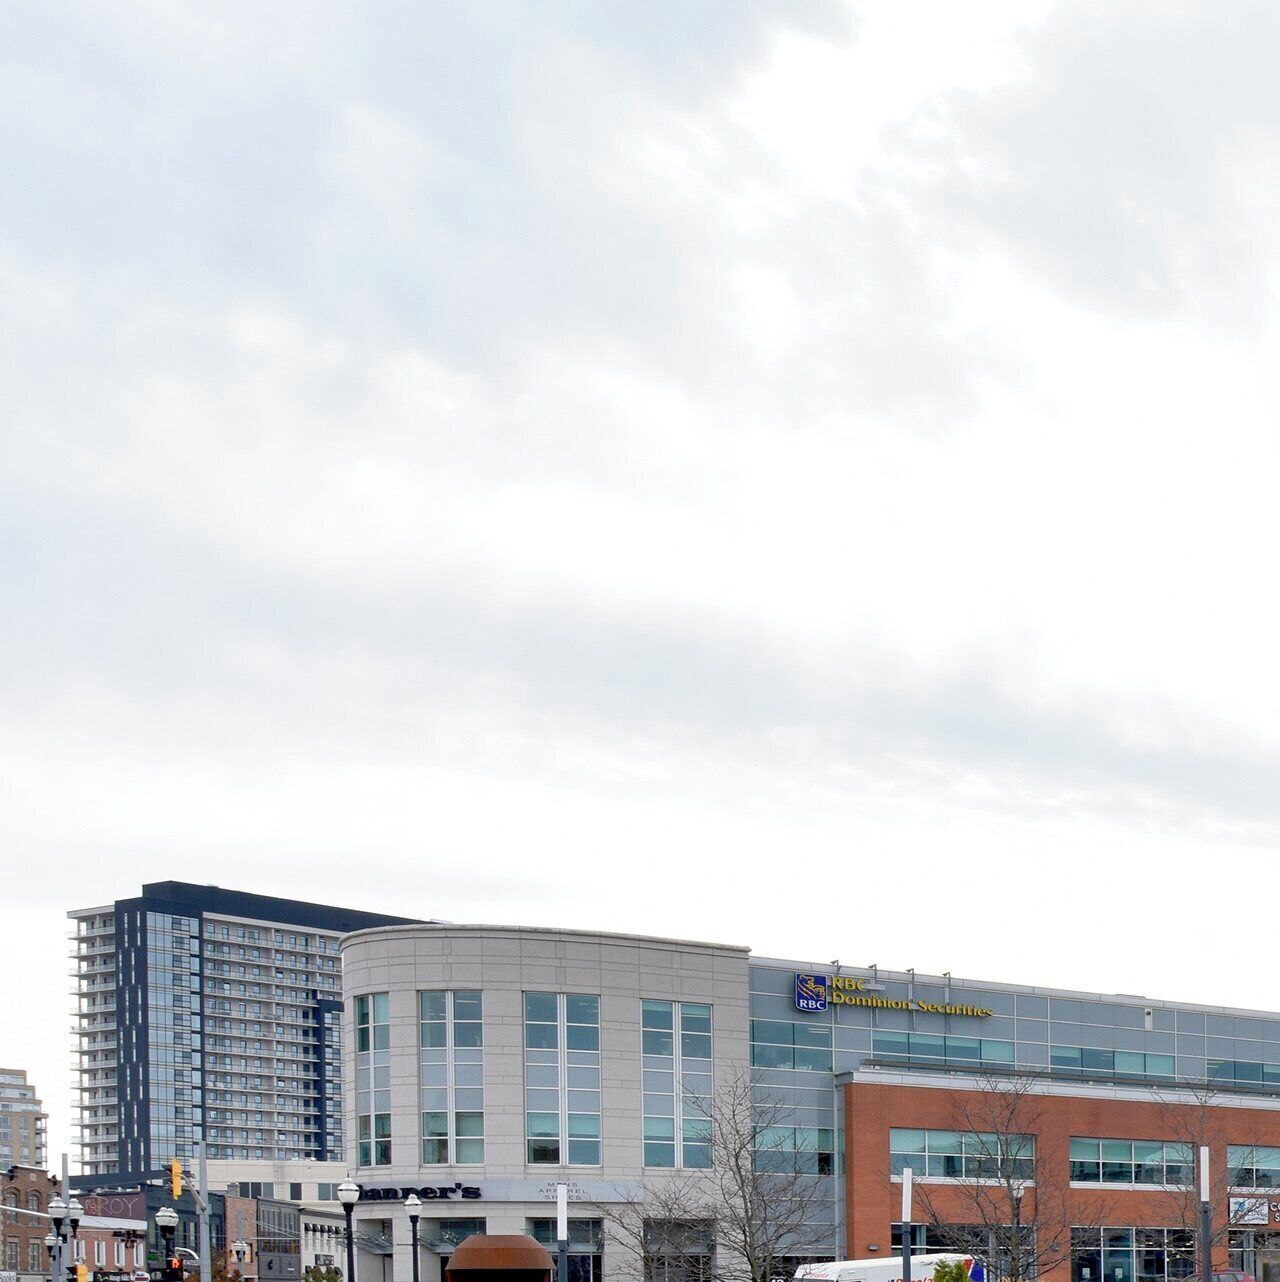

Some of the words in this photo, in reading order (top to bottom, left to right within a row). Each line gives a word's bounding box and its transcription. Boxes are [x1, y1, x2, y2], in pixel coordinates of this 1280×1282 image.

[830, 976, 867, 992] RBC
[799, 999, 826, 1010] RBC
[831, 992, 912, 1010] Dominion
[917, 1000, 994, 1018] Securities
